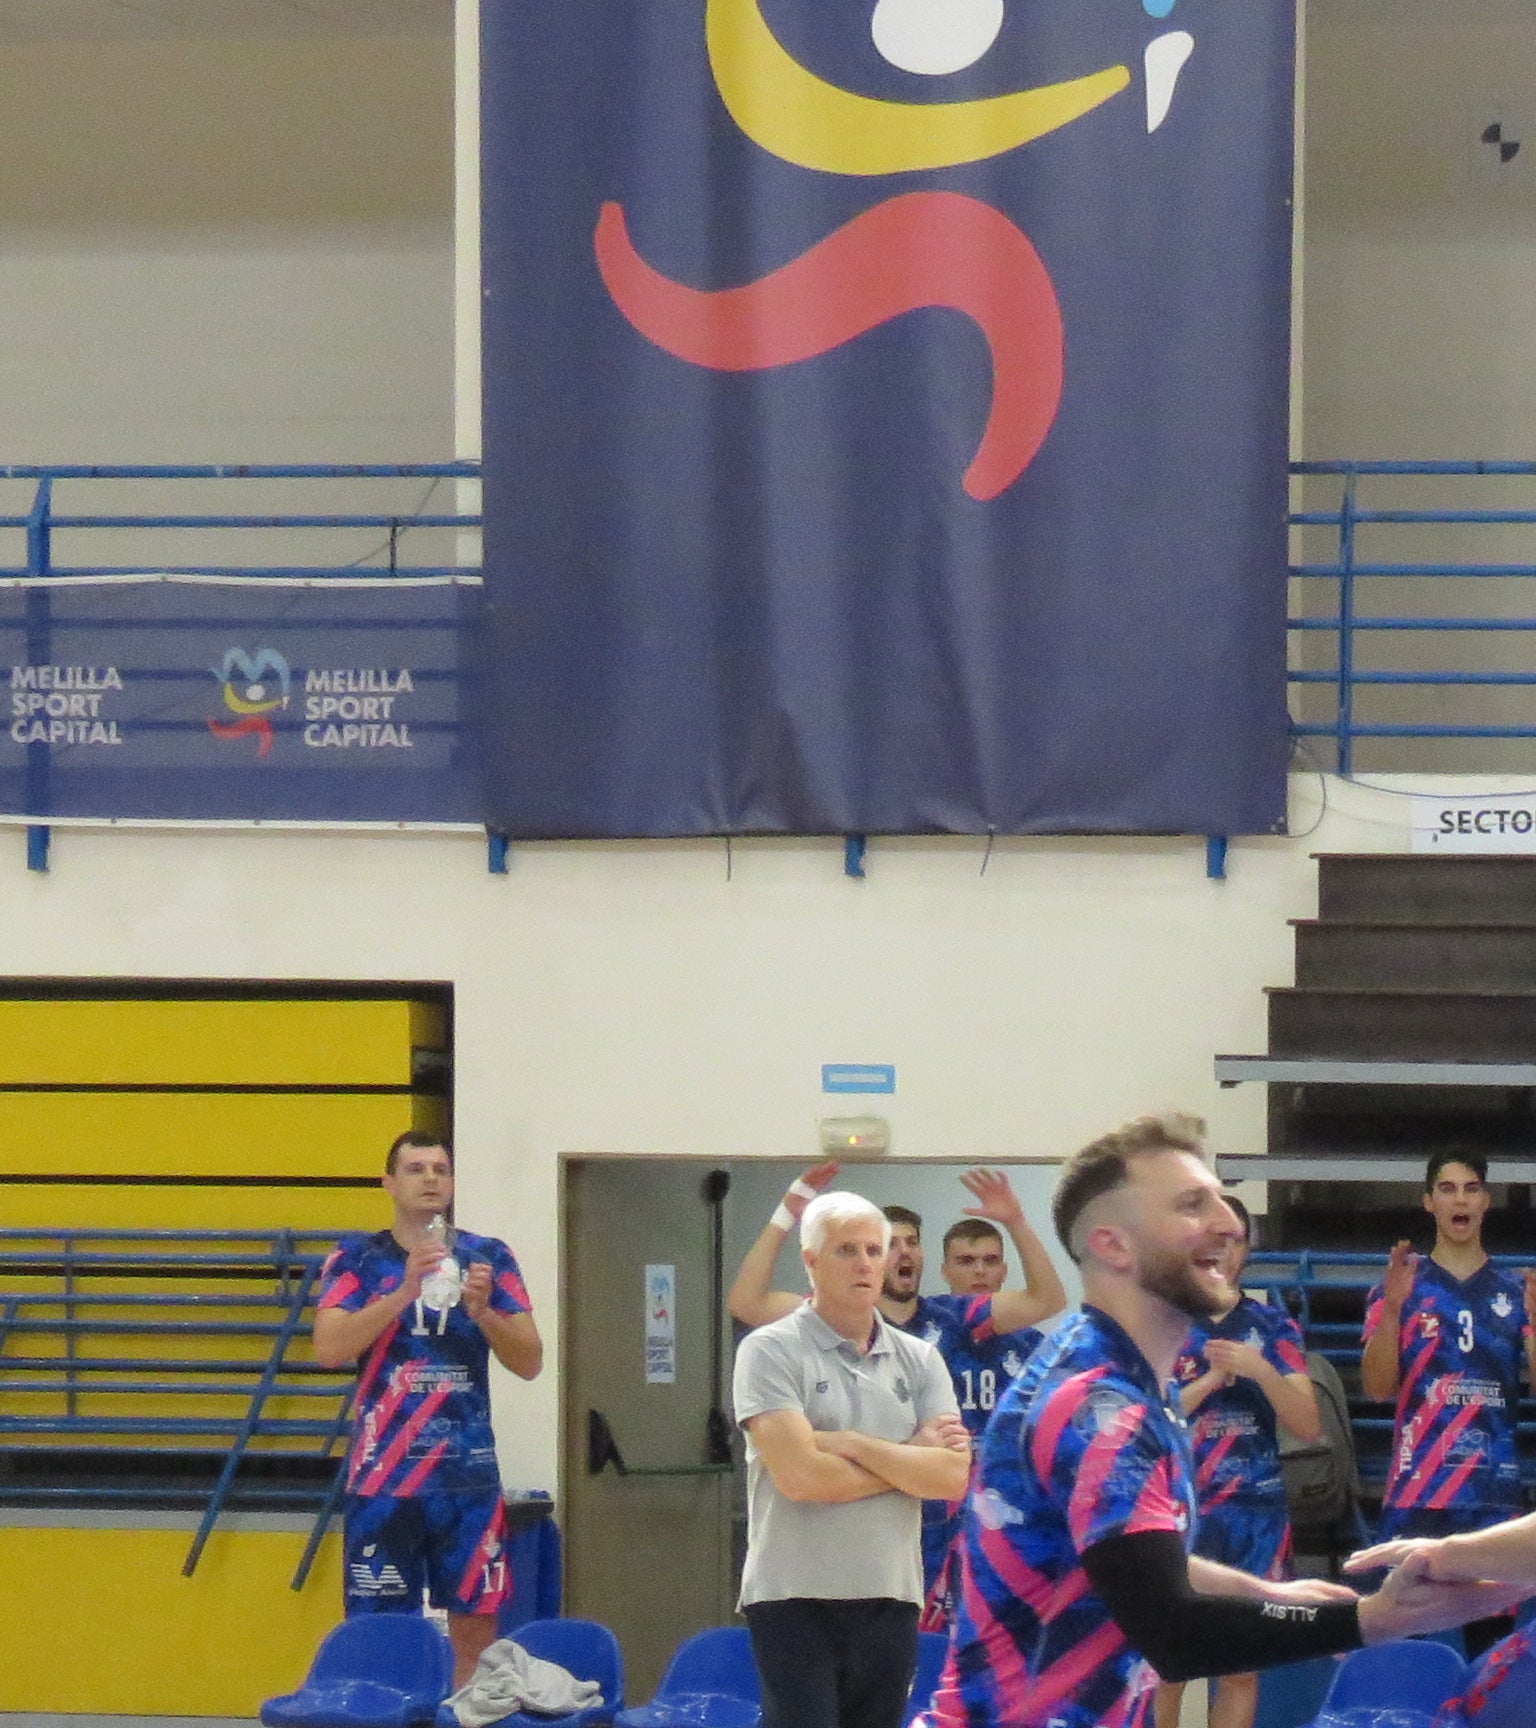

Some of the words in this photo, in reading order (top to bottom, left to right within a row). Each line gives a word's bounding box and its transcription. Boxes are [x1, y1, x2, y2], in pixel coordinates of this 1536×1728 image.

[10, 666, 123, 691] MELILLA
[305, 668, 414, 693] MELILLA
[11, 692, 103, 717] SPORT
[306, 696, 394, 721] SPORT
[11, 720, 123, 744] CAPITAL
[305, 723, 414, 748] CAPITAL
[1458, 1309, 1474, 1353] 3
[961, 1369, 996, 1411] 18
[482, 1561, 506, 1593] 17
[1260, 1601, 1319, 1622] ALLSIX
